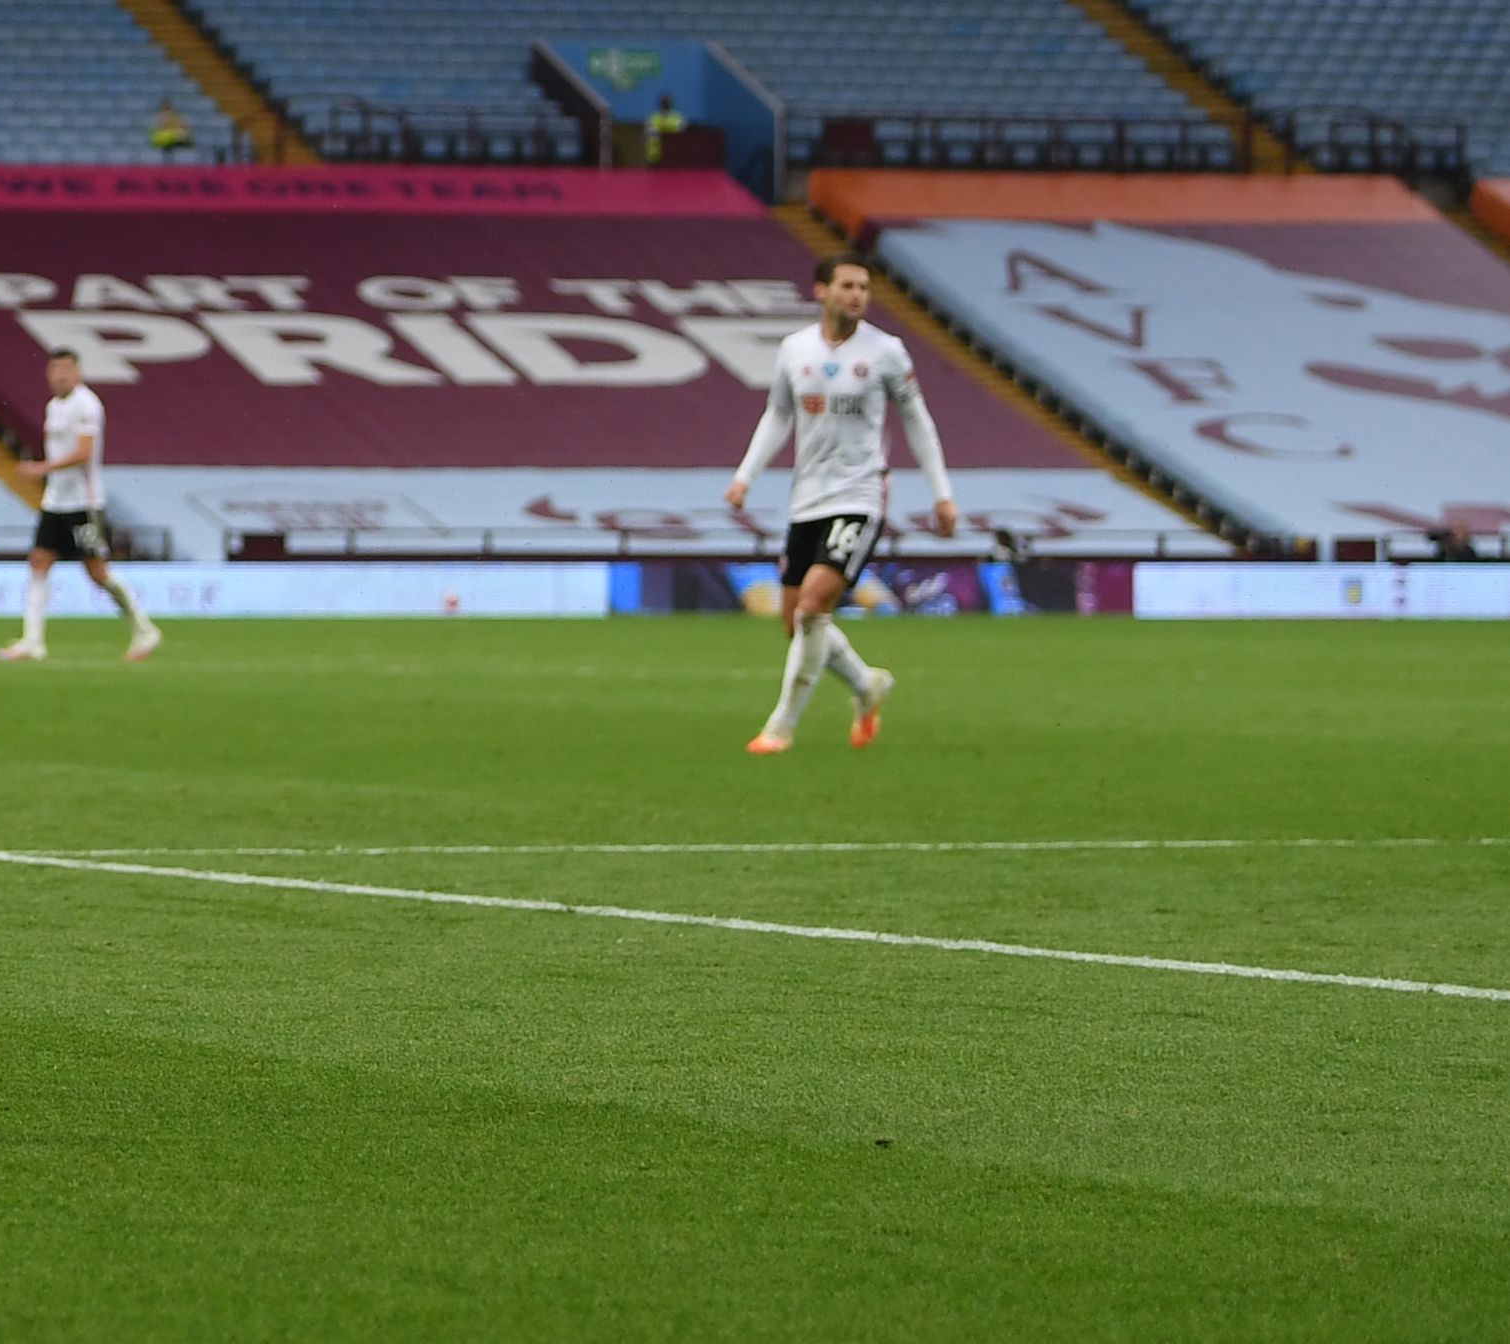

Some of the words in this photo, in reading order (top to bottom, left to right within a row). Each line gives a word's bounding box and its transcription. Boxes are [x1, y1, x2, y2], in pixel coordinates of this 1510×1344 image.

[112, 176, 234, 198] ARE
[246, 177, 374, 199] ONE
[389, 178, 564, 201] TEAM
[355, 276, 522, 313] OF
[549, 278, 822, 316] THE
[15, 310, 815, 390] PRIDE
[826, 517, 862, 563] 16
